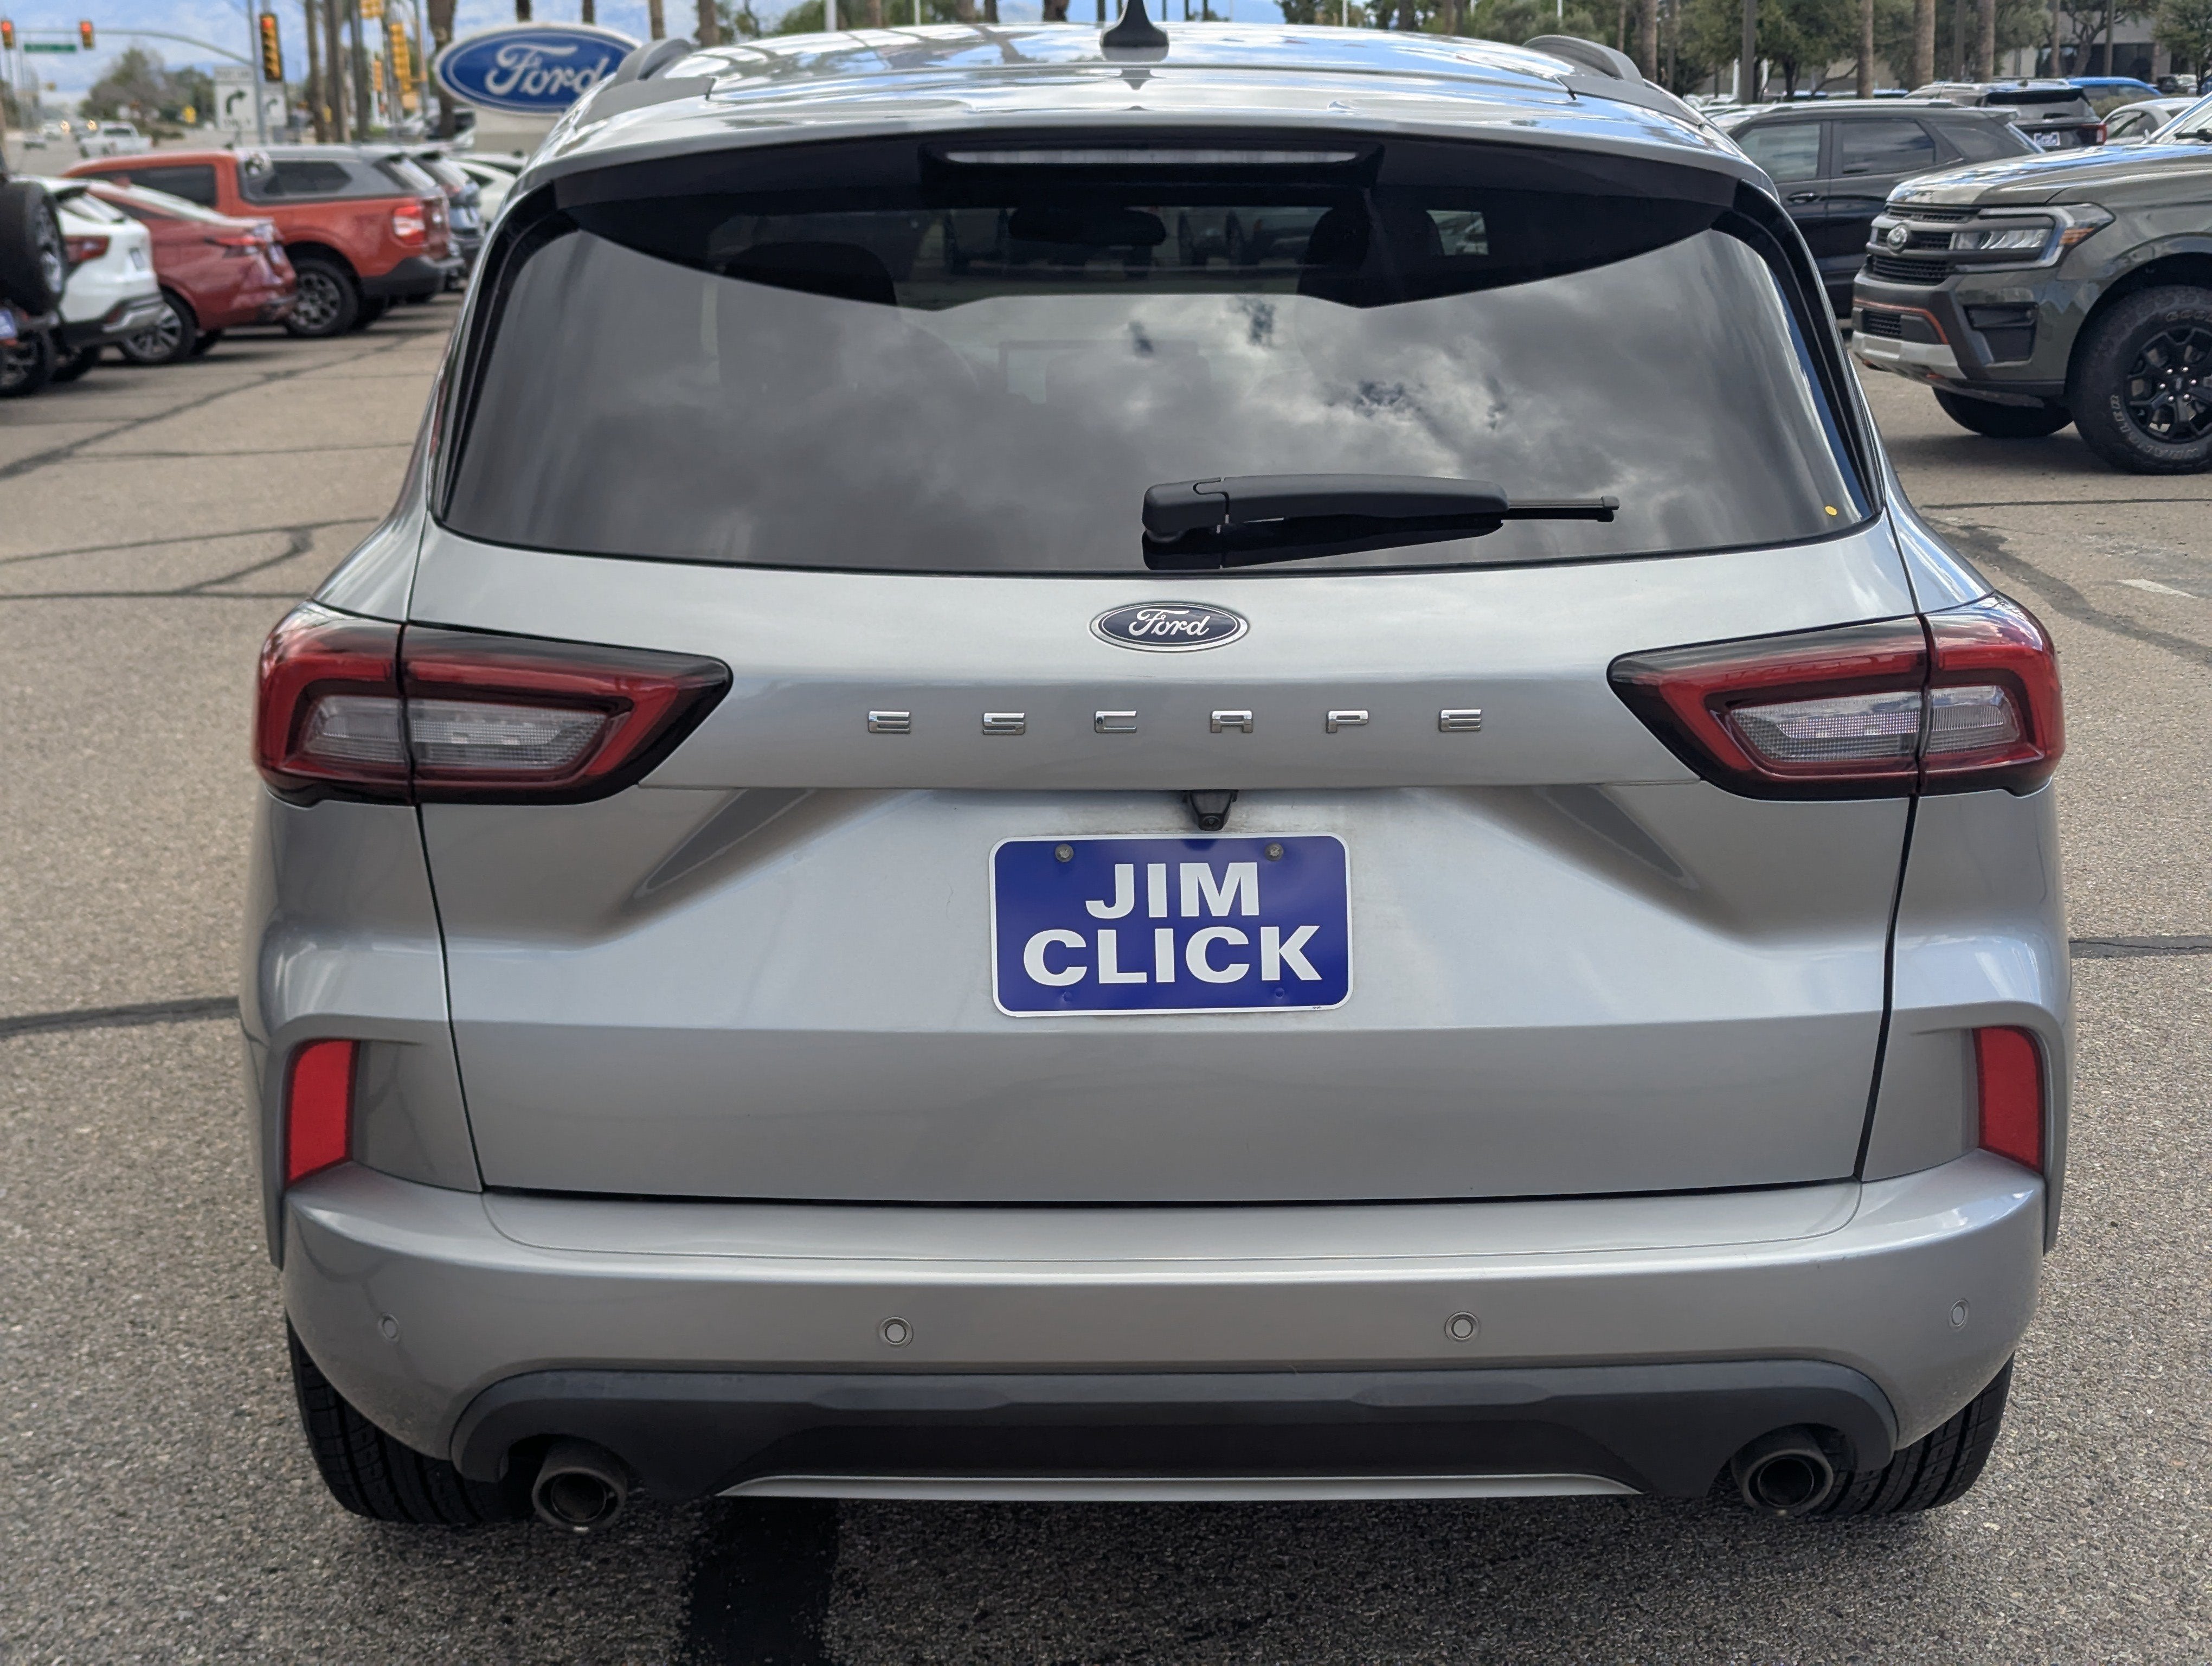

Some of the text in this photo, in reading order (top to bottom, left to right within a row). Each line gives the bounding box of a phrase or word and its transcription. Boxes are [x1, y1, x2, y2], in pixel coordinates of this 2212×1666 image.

[484, 43, 610, 95] Ford
[1128, 608, 1210, 636] Ford
[868, 709, 1481, 734] ESCAPE
[1085, 862, 1259, 919] JIM
[1023, 925, 1322, 986] CLICK
